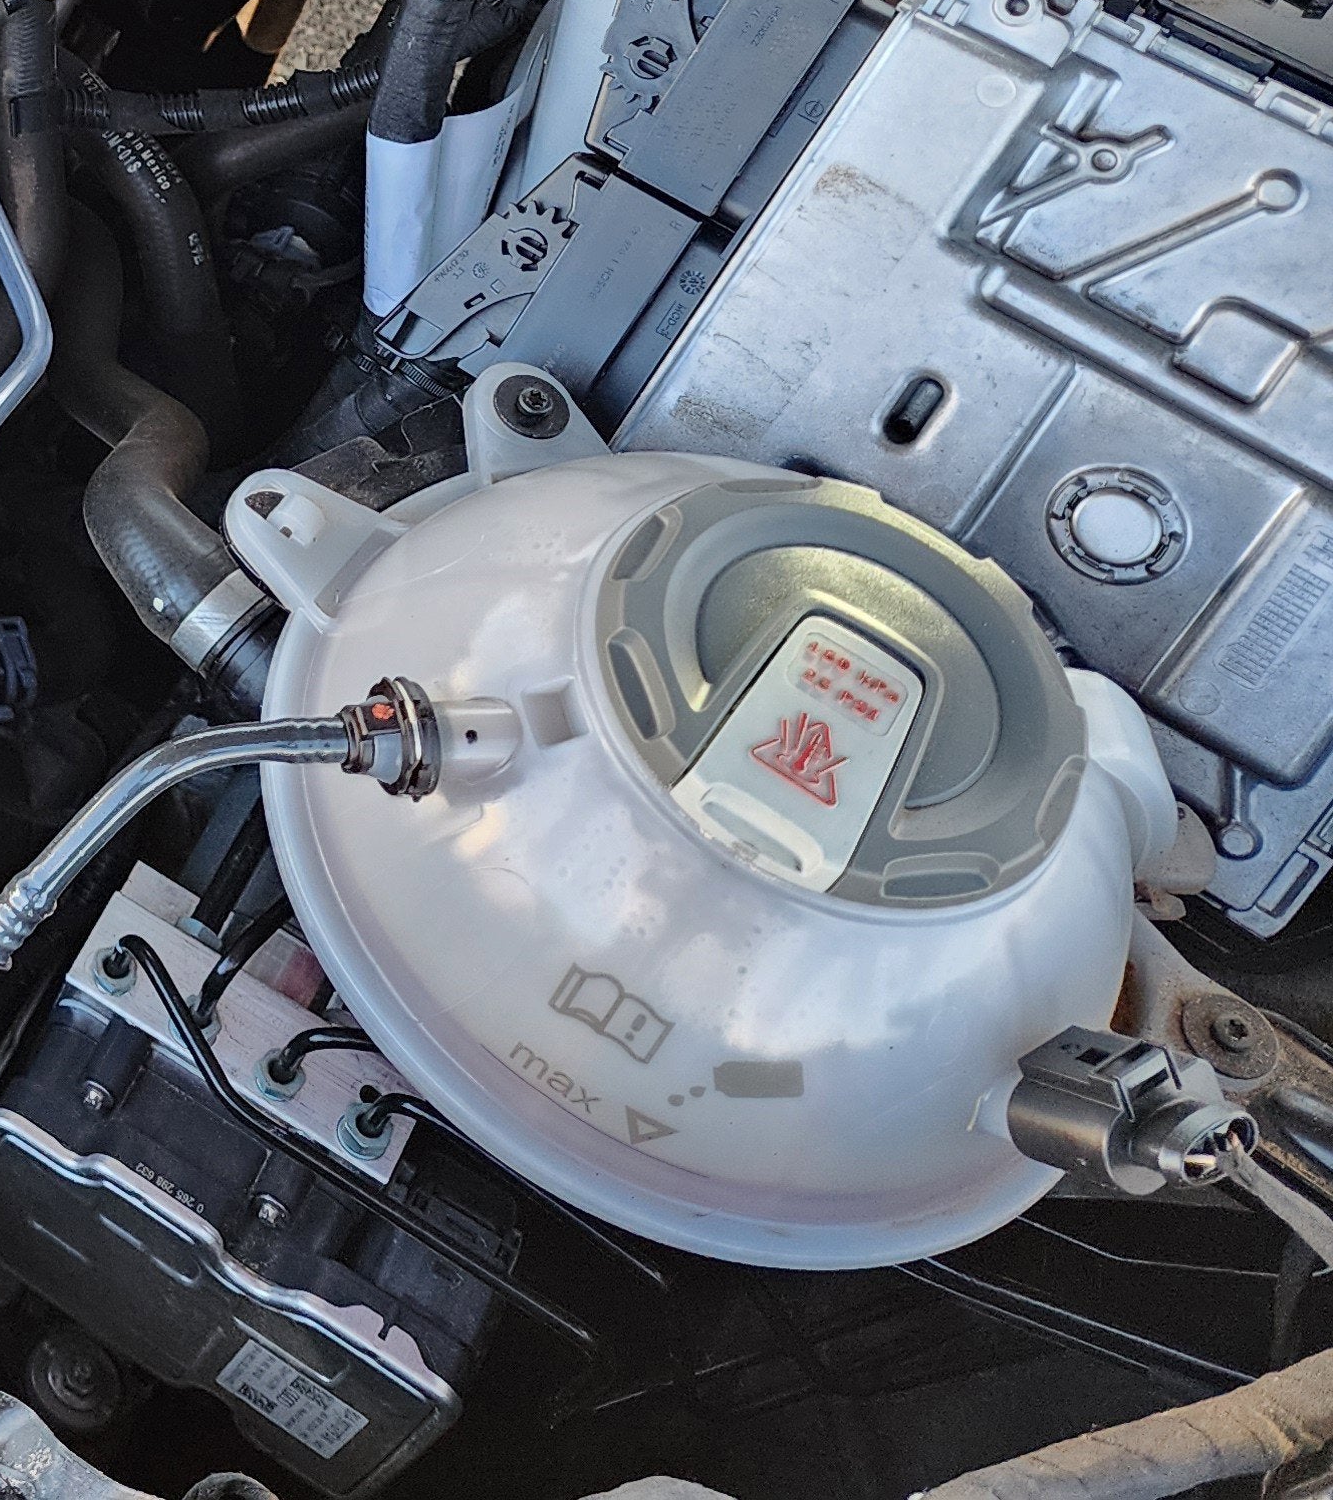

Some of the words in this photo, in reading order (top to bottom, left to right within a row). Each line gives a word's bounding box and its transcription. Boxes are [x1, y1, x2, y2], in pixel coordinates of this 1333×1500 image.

[141, 149, 171, 191] Mexico
[508, 1038, 603, 1116] max
[173, 1188, 196, 1207] 265
